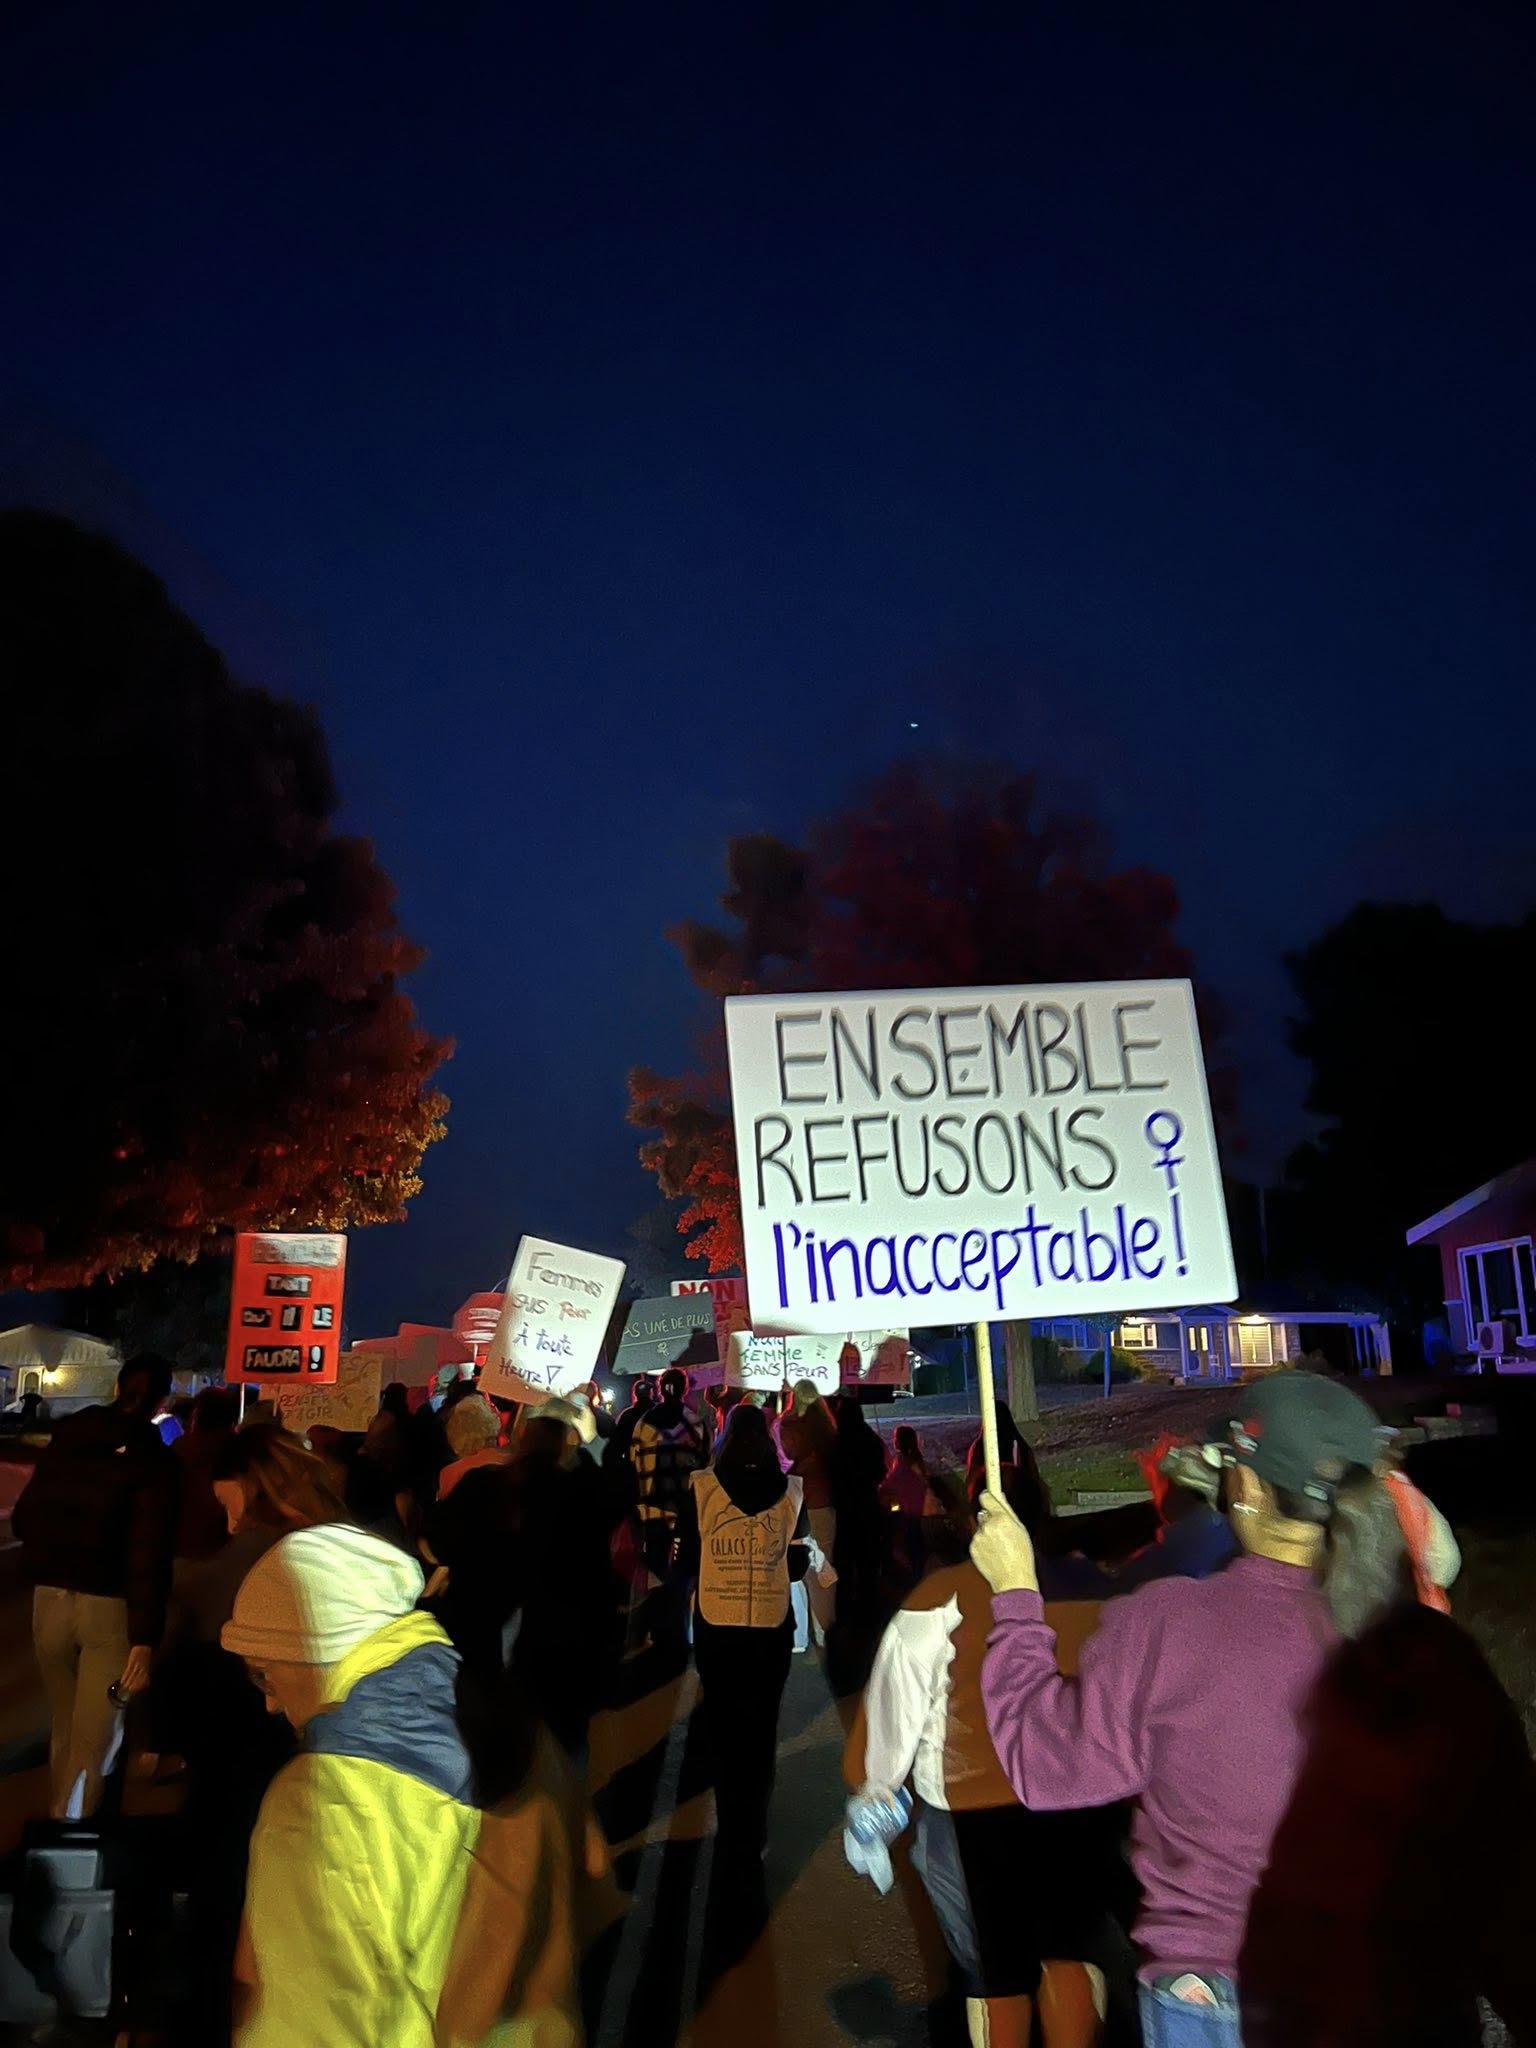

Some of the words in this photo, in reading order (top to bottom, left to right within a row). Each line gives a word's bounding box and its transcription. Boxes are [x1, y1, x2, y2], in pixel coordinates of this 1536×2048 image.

[775, 1000, 1169, 1106] ENSEMBLE
[754, 1106, 1118, 1210] REFUSONS
[312, 1307, 333, 1327] LE
[623, 1322, 641, 1338] AS
[670, 1315, 685, 1331] DE
[685, 1312, 711, 1327] PLUS
[245, 1348, 300, 1369] FAUDRA
[740, 1362, 782, 1379] SANS
[710, 1537, 746, 1557] CALACS
